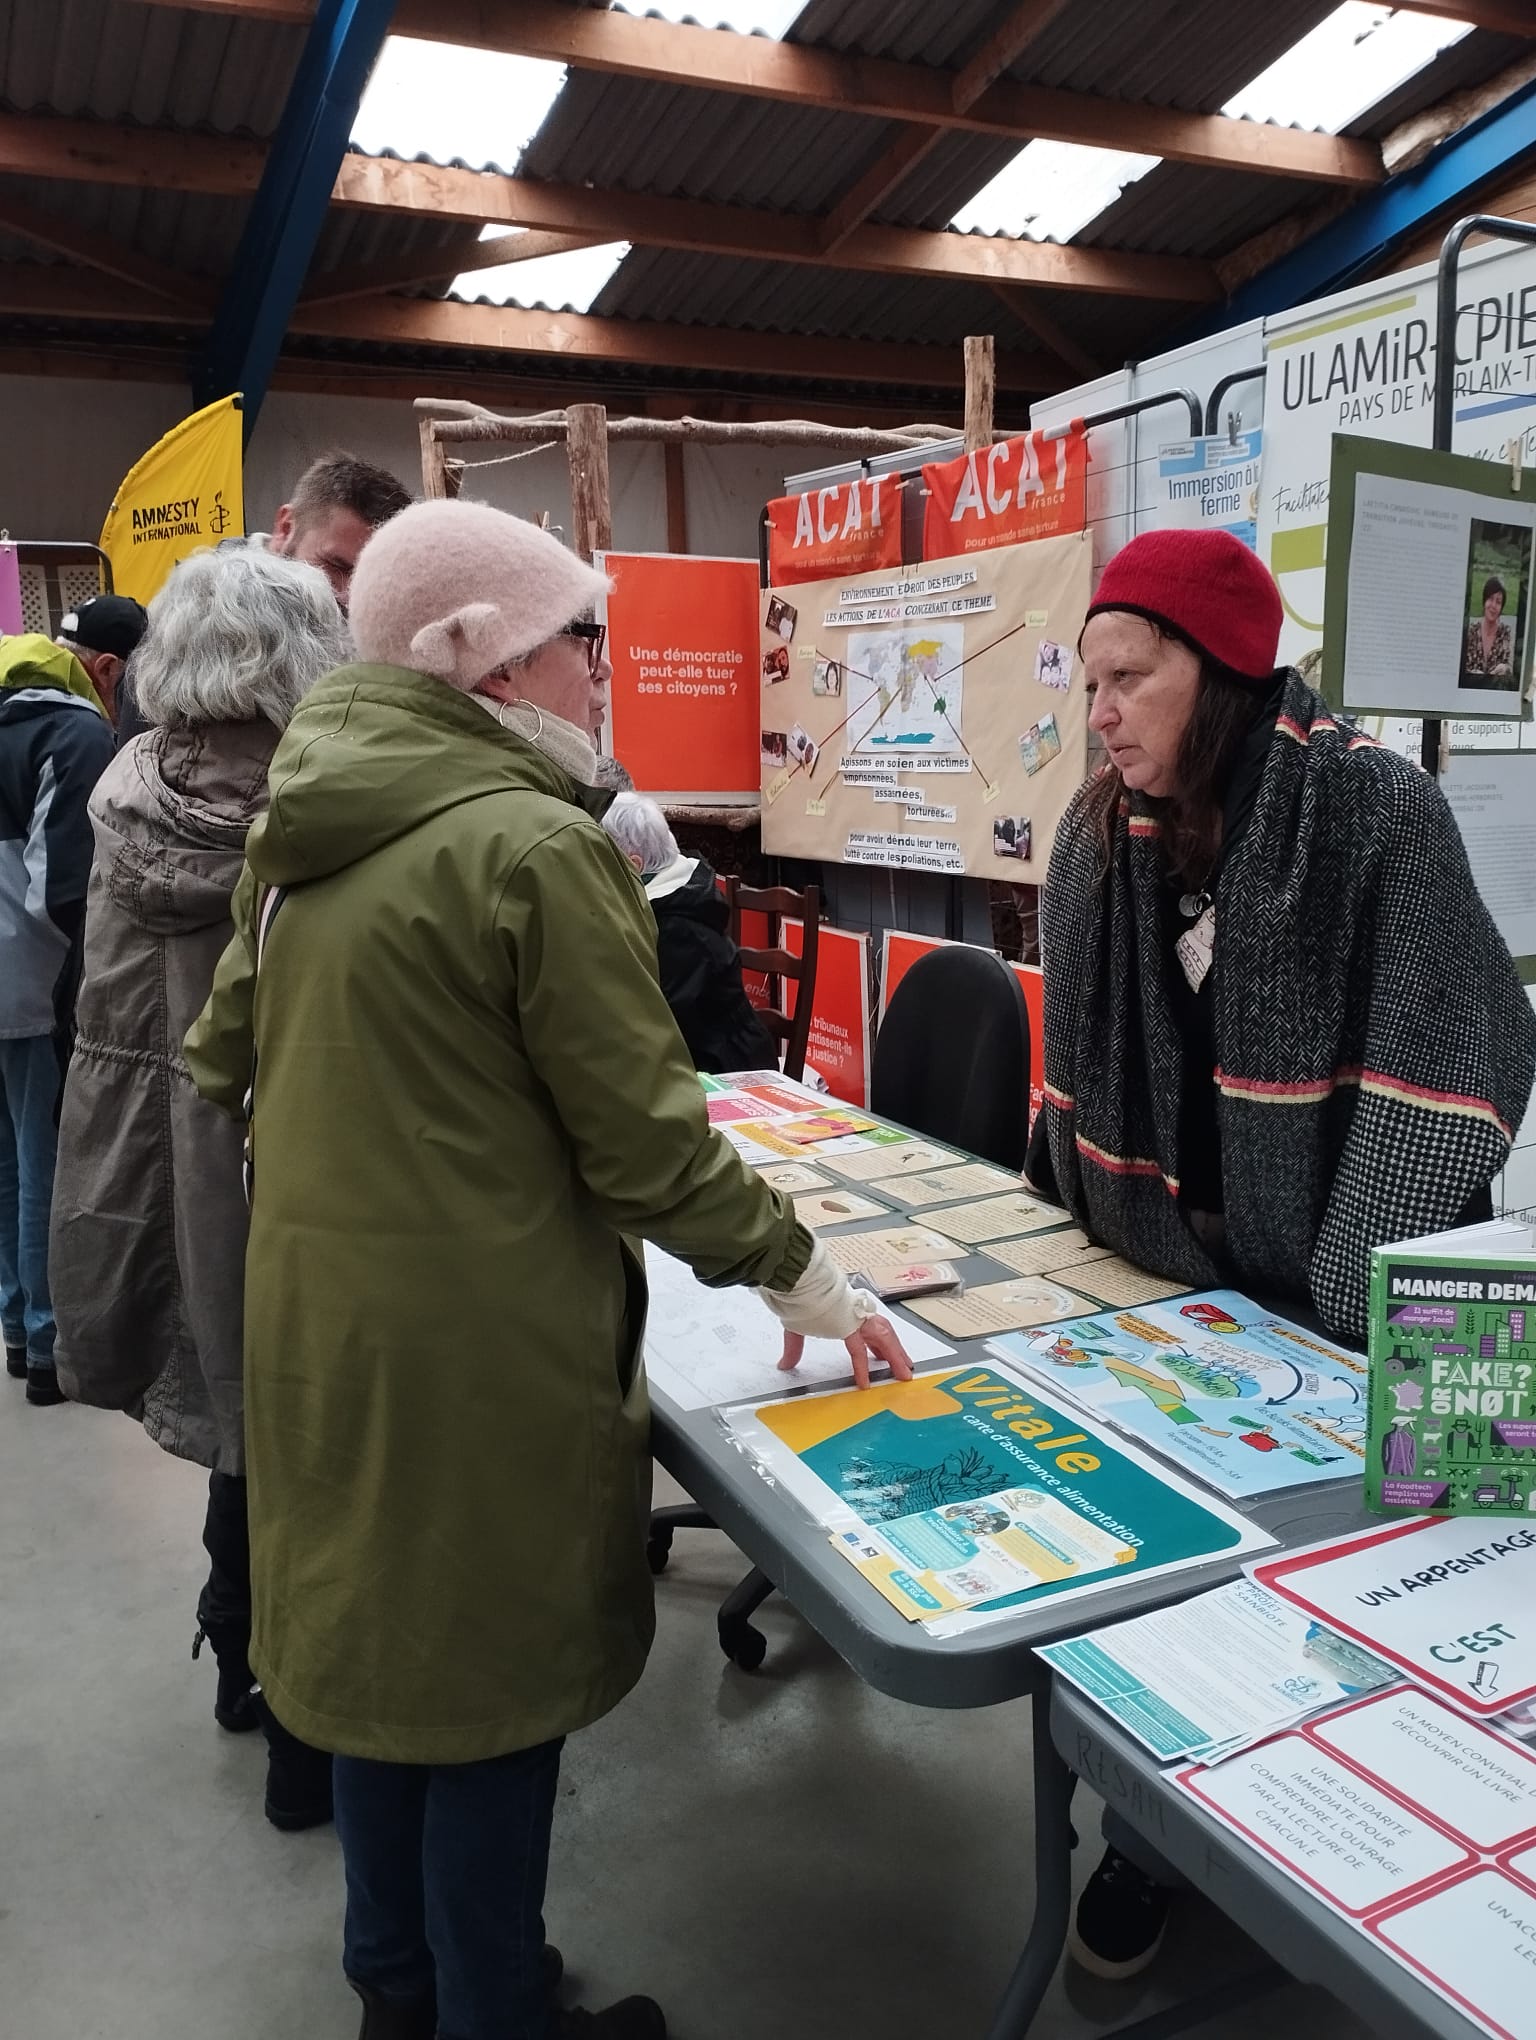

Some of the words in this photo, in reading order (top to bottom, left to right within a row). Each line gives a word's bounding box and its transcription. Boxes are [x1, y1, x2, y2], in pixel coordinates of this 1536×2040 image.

[1339, 394, 1384, 426] PAYS
[1391, 385, 1414, 414] DE
[1421, 354, 1536, 408] MRLAIX-T
[950, 422, 1073, 522] ACAT
[1169, 470, 1243, 500] Immersion
[1246, 464, 1252, 486] à
[132, 497, 200, 529] AMNESTY
[792, 473, 890, 549] ACAT
[1031, 493, 1066, 510] france
[1200, 493, 1241, 517] ferme
[132, 522, 202, 545] INTERNATIONAL
[965, 538, 987, 549] pour
[841, 586, 894, 601] ENVIRONNEMENT
[927, 580, 941, 590] DES
[943, 572, 974, 587] PEUPLES
[826, 613, 836, 622] LES
[838, 611, 864, 621] ACTIONS
[867, 610, 877, 620] DE
[905, 602, 948, 616] CONCERNANT
[952, 601, 962, 611] CE
[630, 646, 659, 660] Une
[663, 648, 743, 663] démocratie
[639, 665, 703, 679] peut-elle
[706, 666, 735, 679] tuer
[638, 682, 662, 694] ses
[666, 681, 726, 697] citoyens
[729, 682, 738, 695] ?
[1452, 722, 1465, 735] de
[1468, 723, 1513, 738] supports
[841, 757, 872, 768] Agissons
[917, 759, 931, 767] aux
[934, 757, 969, 768] victimes
[850, 833, 865, 843] pour
[867, 834, 883, 844] avoir
[917, 837, 932, 848] leur
[936, 840, 960, 853] terre,
[862, 851, 884, 861] contre
[947, 861, 963, 869] etc.
[814, 1016, 849, 1039] tribunaux
[808, 1034, 852, 1056] antissent-ils
[812, 1048, 838, 1065] justice
[1393, 1278, 1483, 1300] MANGER
[1403, 1315, 1430, 1324] manger
[1432, 1316, 1454, 1324] local
[1423, 1306, 1444, 1316] suffit
[1272, 1328, 1289, 1337] LA
[1292, 1335, 1329, 1356] CAISSE
[1431, 1360, 1533, 1389] FAKE?
[1430, 1387, 1452, 1415] OR
[952, 1373, 1100, 1474] Vitale
[1292, 1413, 1313, 1424] LES
[963, 1414, 994, 1435] carte
[990, 1432, 1061, 1487] d'assurance
[1057, 1484, 1145, 1547] alimentation
[1385, 1481, 1395, 1489] La
[1396, 1482, 1432, 1490] foodtech
[1355, 1586, 1402, 1606] UN
[1400, 1530, 1536, 1592] ARPENTAGE
[1235, 1592, 1287, 1626] SAINBIOTE
[1247, 1589, 1281, 1612] PROJET
[1429, 1623, 1517, 1663] C'EST
[1399, 1707, 1420, 1720] UN
[1418, 1720, 1462, 1748] MOYEN
[1462, 1747, 1527, 1790] CONVIVIAL
[1462, 1764, 1485, 1779] UN
[1482, 1778, 1522, 1803] LIVRE
[1290, 1772, 1357, 1821] IMMÉDIATE
[1356, 1820, 1395, 1848] POUR
[1310, 1766, 1339, 1786] UNE
[1337, 1786, 1412, 1838] SOLIDARITÉ
[1249, 1783, 1276, 1802] PAR
[1272, 1801, 1291, 1815] LA
[1288, 1811, 1346, 1856] LECTURE
[1343, 1854, 1366, 1870] DE
[1250, 1763, 1333, 1824] COMPRENDRE
[1329, 1822, 1404, 1877] L'OUVRAGE
[1255, 1809, 1320, 1858] CHACUN.E
[1487, 1900, 1513, 1919] UN
